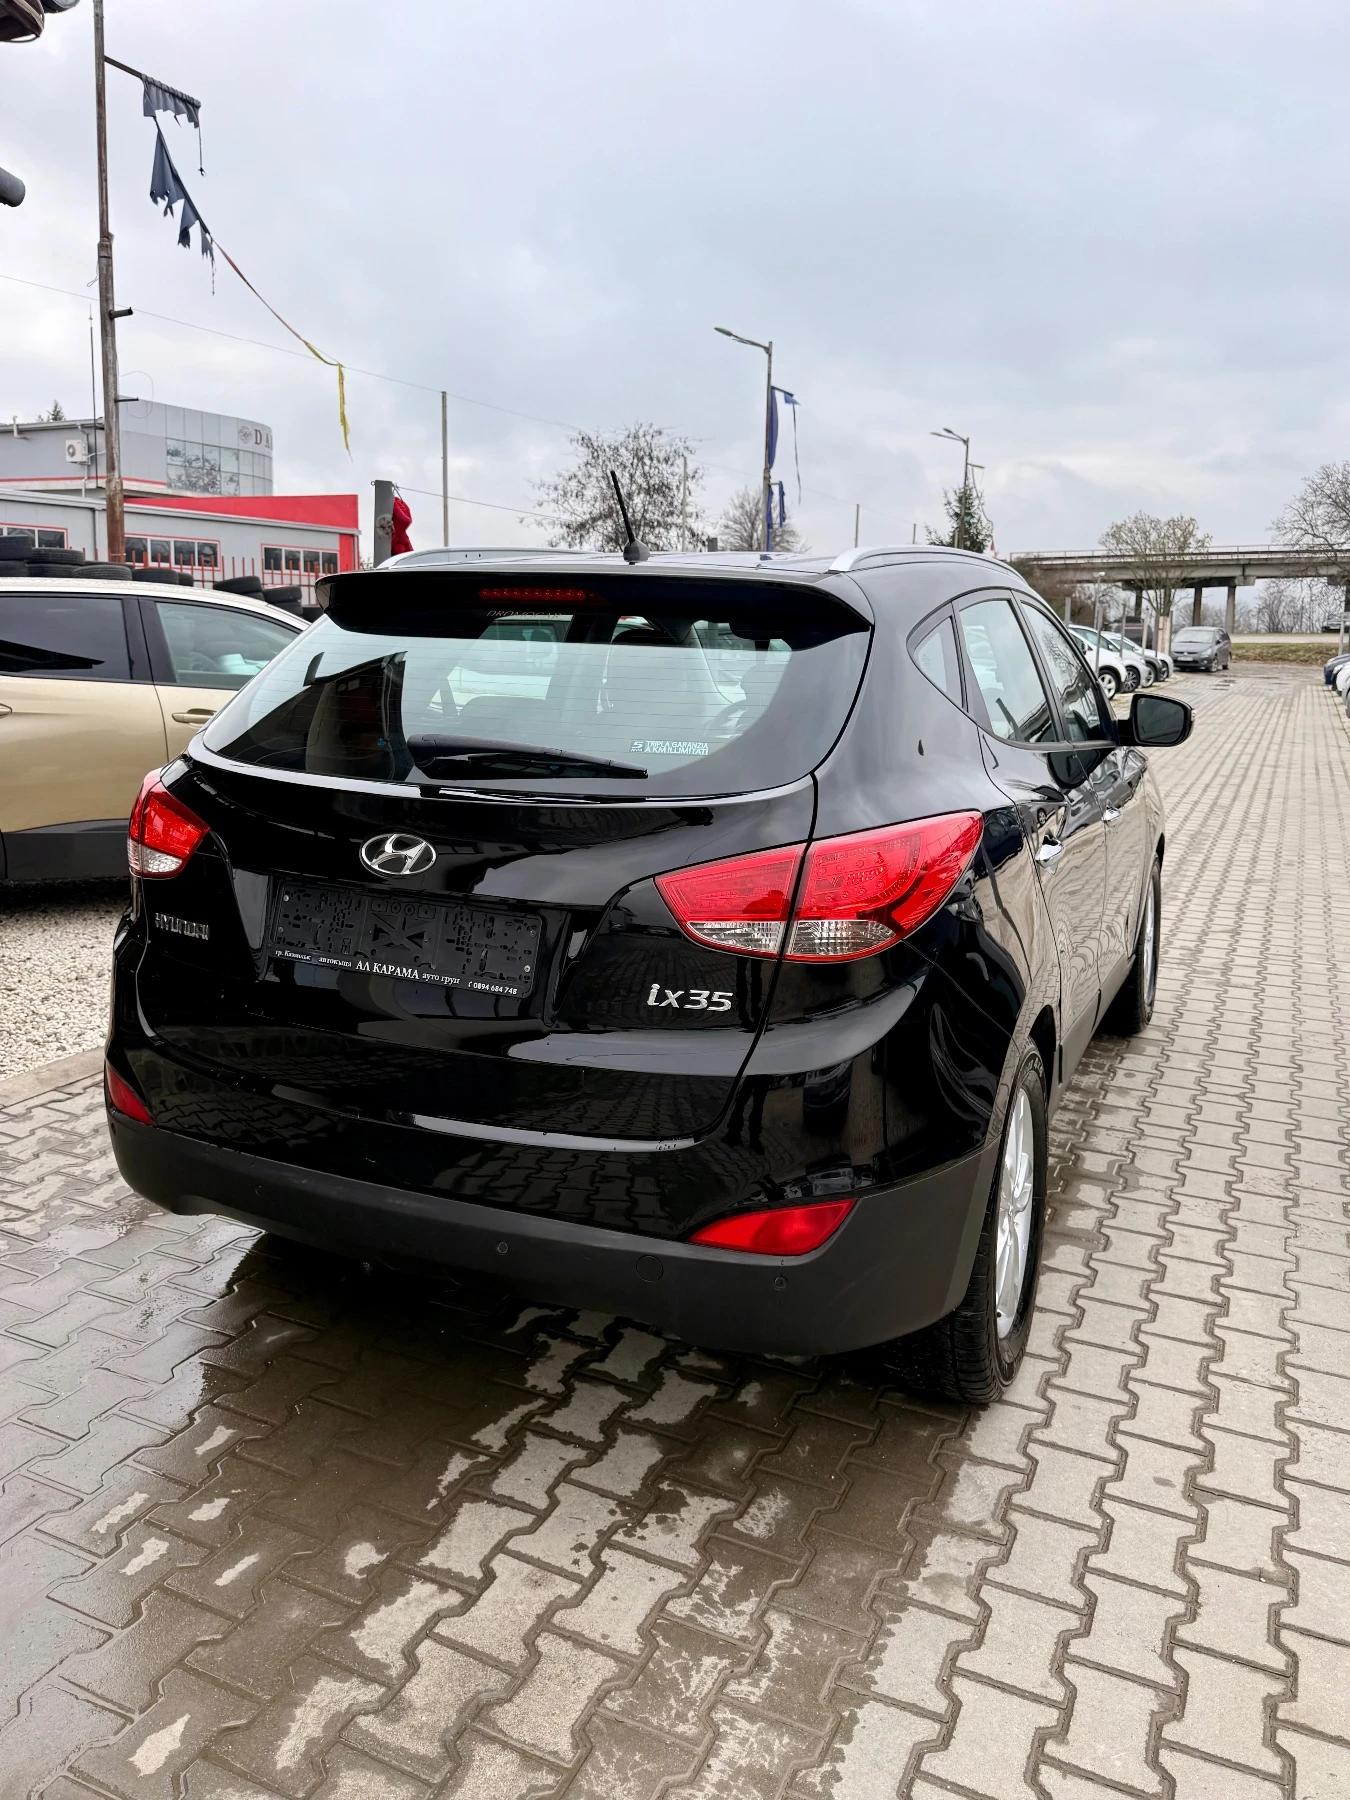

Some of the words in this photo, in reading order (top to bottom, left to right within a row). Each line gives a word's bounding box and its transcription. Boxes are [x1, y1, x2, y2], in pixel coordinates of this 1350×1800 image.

[645, 740, 670, 748] TRIPLA
[671, 741, 708, 749] GARANZIA
[356, 960, 371, 972] АЛ
[373, 962, 420, 980] КАРАМА
[422, 973, 440, 982] ауто
[440, 976, 460, 986] груп
[473, 982, 490, 991] 0894
[504, 986, 518, 995] 748
[646, 983, 734, 1012] ix35
